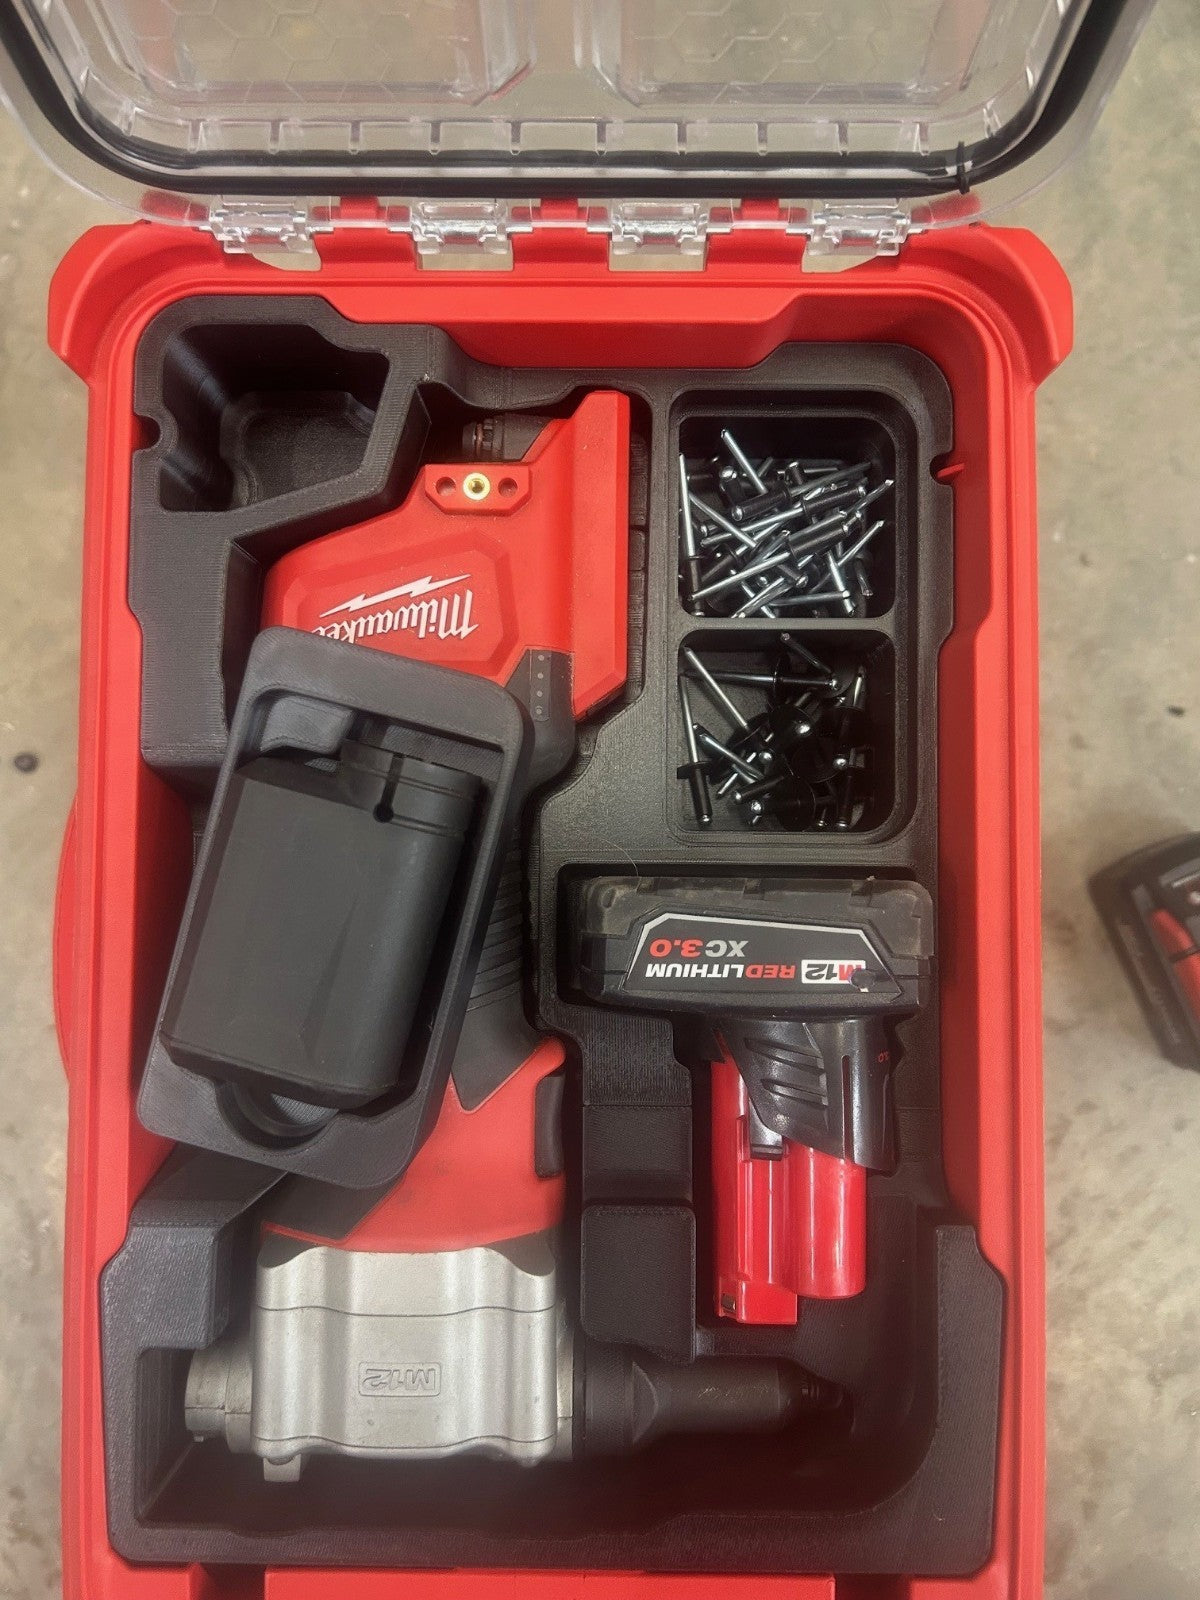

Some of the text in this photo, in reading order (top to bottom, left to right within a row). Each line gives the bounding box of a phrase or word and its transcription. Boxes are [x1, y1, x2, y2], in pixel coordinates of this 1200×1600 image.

[650, 938, 748, 958] XC3.0
[645, 963, 797, 979] REDLITHIUM
[362, 1368, 435, 1390] M12
